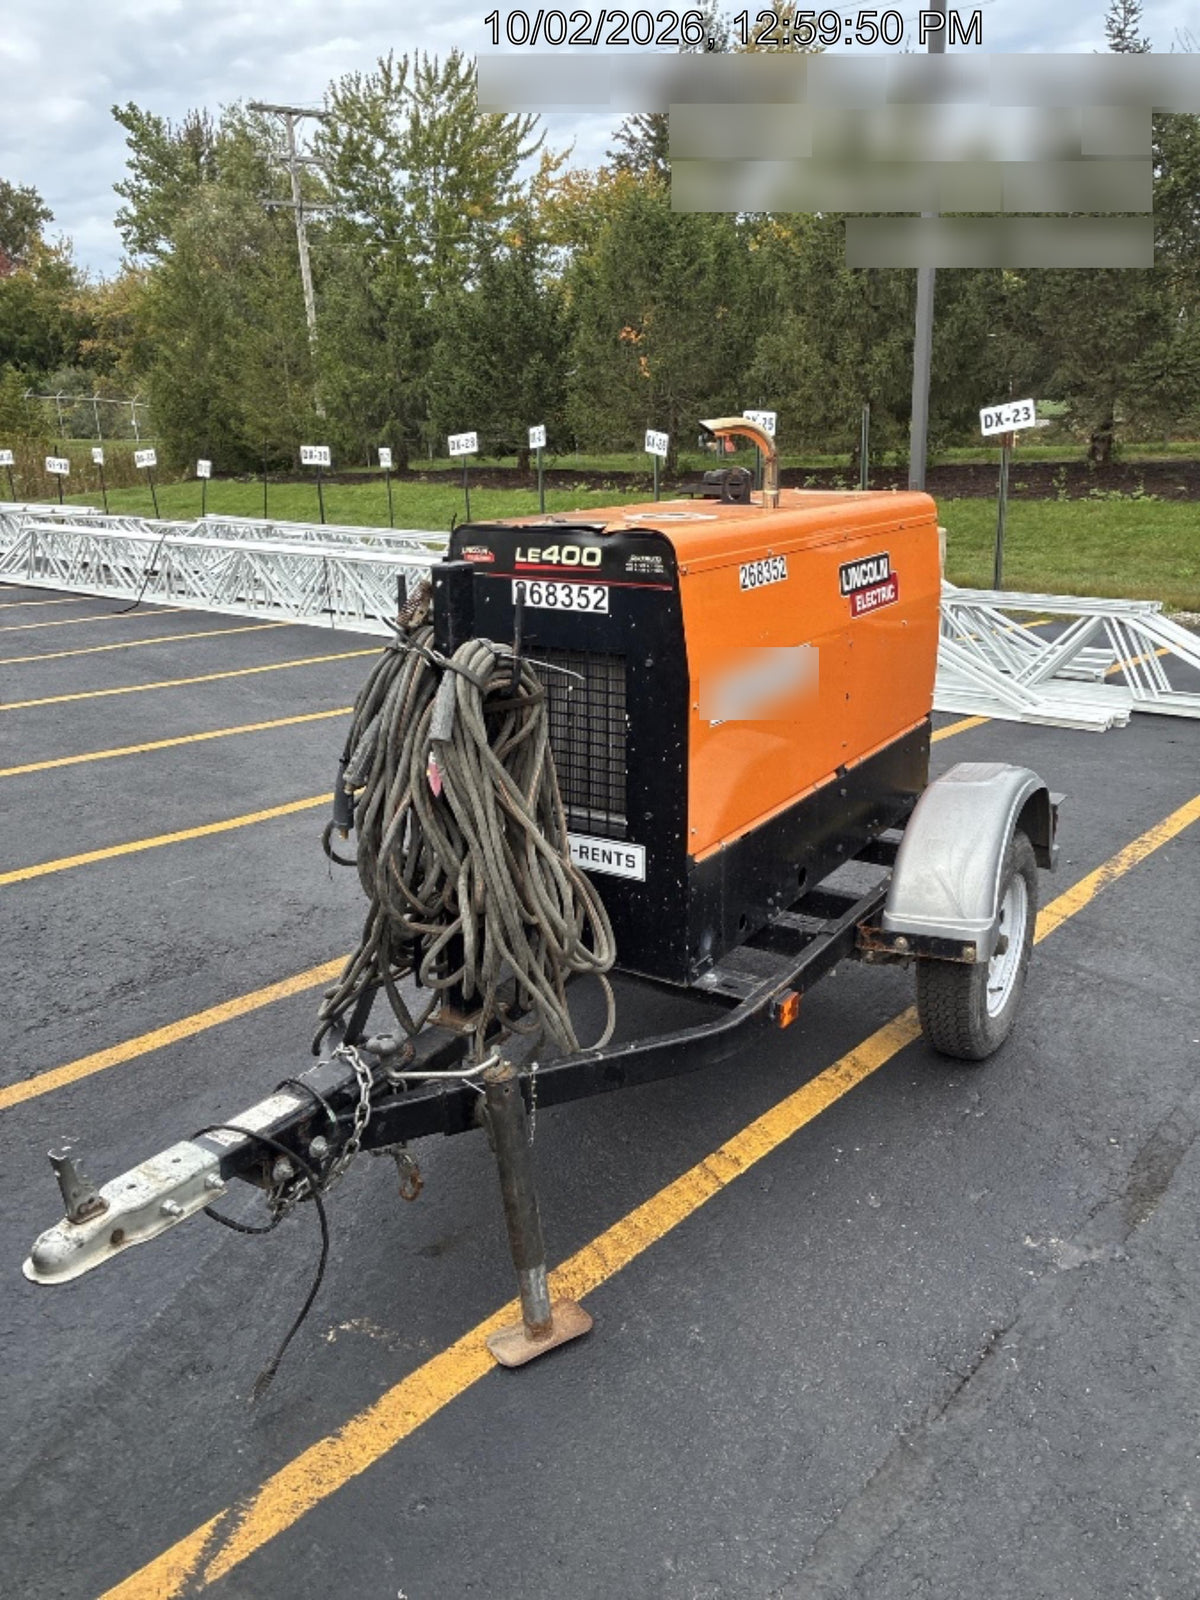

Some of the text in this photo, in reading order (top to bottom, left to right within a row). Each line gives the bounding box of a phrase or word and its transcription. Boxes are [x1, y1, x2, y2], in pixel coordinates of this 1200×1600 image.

[984, 406, 1031, 429] DX-23
[515, 545, 602, 567] LE400
[740, 556, 787, 589] 268352
[841, 557, 889, 592] LINCOLN
[855, 584, 895, 613] ELECTRIC
[568, 843, 636, 869] -RENTS
